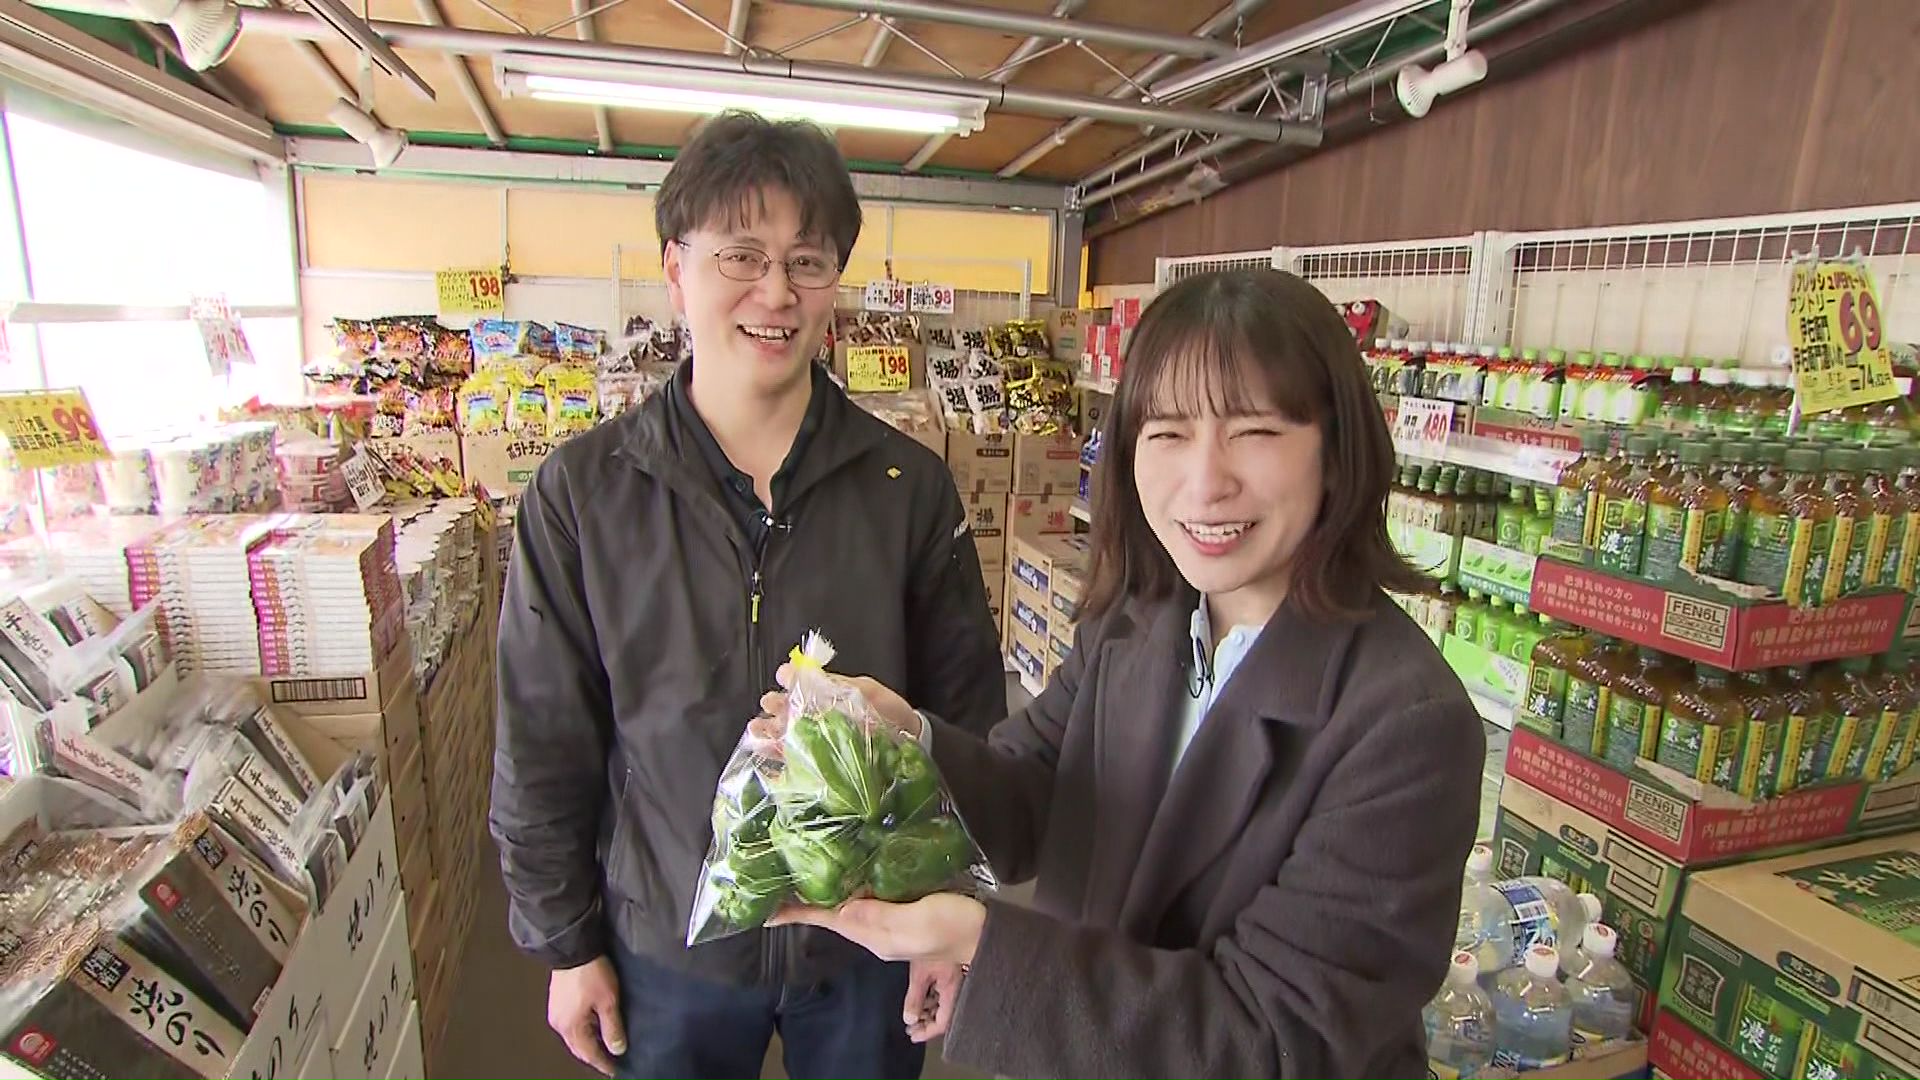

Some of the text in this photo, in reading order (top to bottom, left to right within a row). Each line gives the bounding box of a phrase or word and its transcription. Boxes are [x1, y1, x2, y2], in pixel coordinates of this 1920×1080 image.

[470, 277, 500, 297] 198
[935, 290, 951, 305] 98
[1840, 290, 1881, 354] 69
[879, 355, 907, 376] 198
[52, 407, 97, 440] 99
[506, 441, 556, 460] ポテトチップ
[1673, 600, 1721, 623] FEN6L
[1635, 789, 1679, 818] FEN6L
[228, 866, 289, 947] 焼のり
[127, 977, 225, 1058] 焼のり
